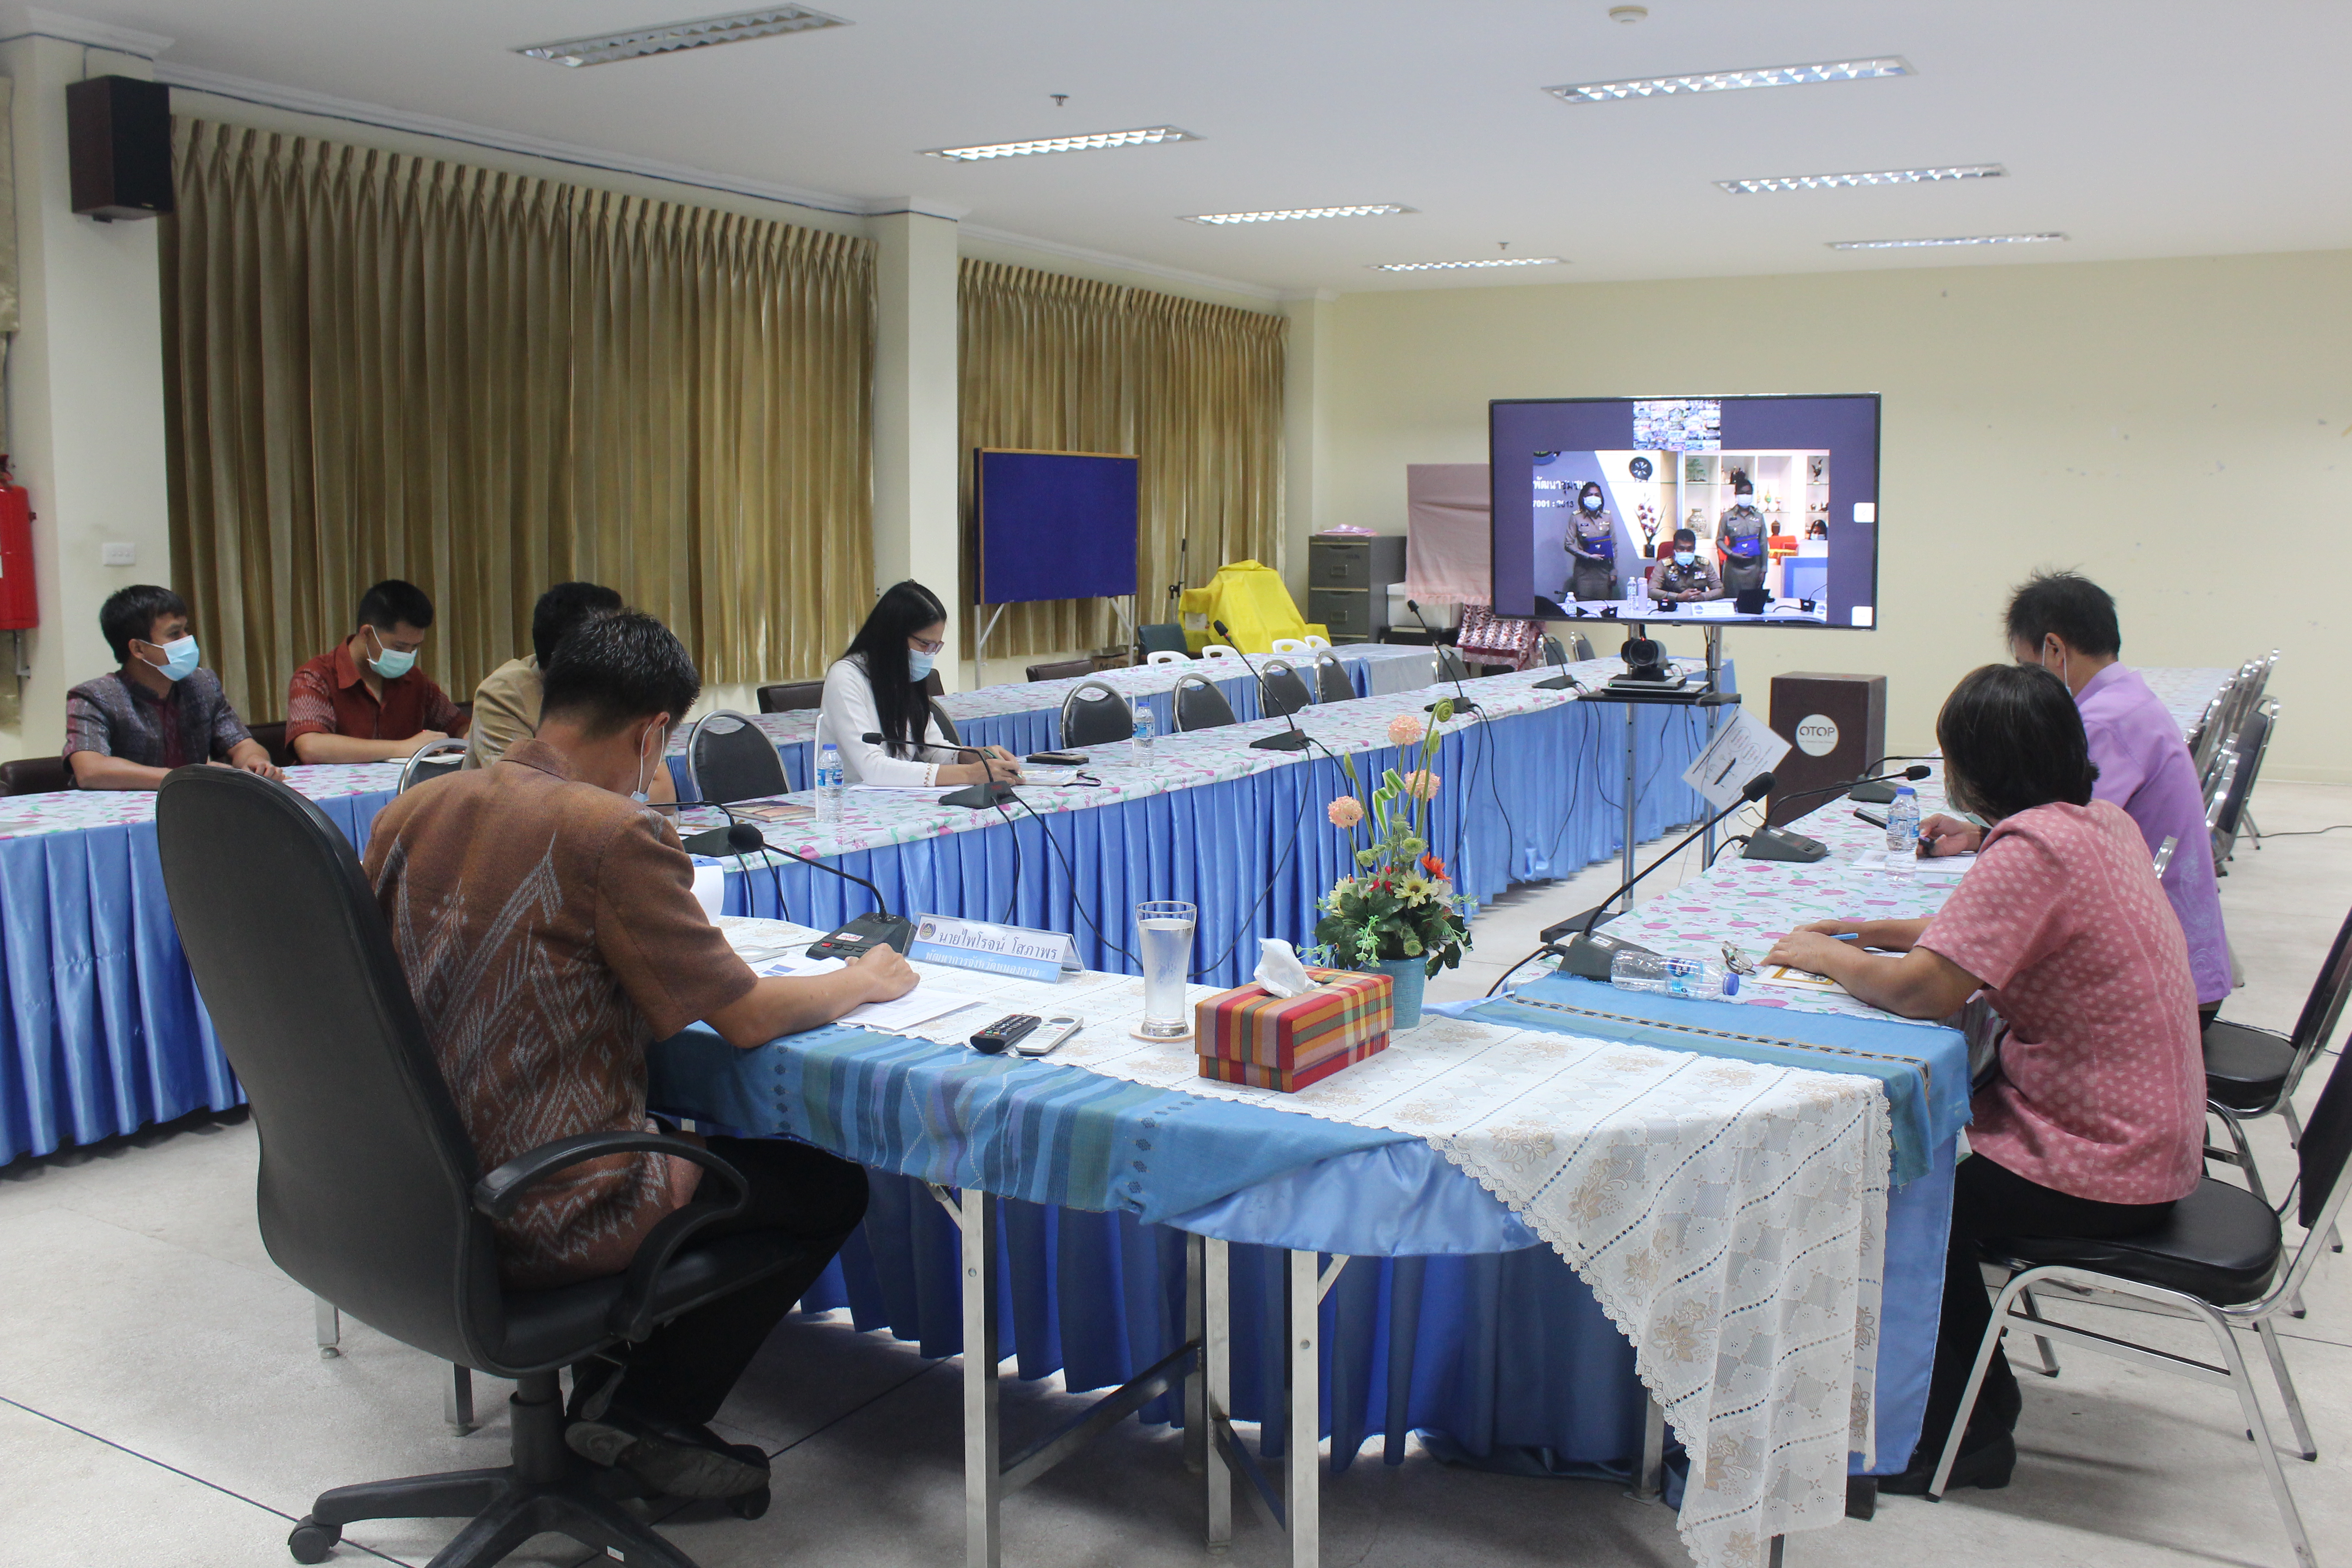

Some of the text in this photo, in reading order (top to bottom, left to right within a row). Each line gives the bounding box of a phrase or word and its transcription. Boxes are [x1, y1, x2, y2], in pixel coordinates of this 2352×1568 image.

[1799, 726, 1835, 736] OTOP
[939, 928, 1058, 960] นายไพโรจน์ โสภาพร
[926, 949, 1040, 977] พัฒนาการจังหวัดหนองคาย
